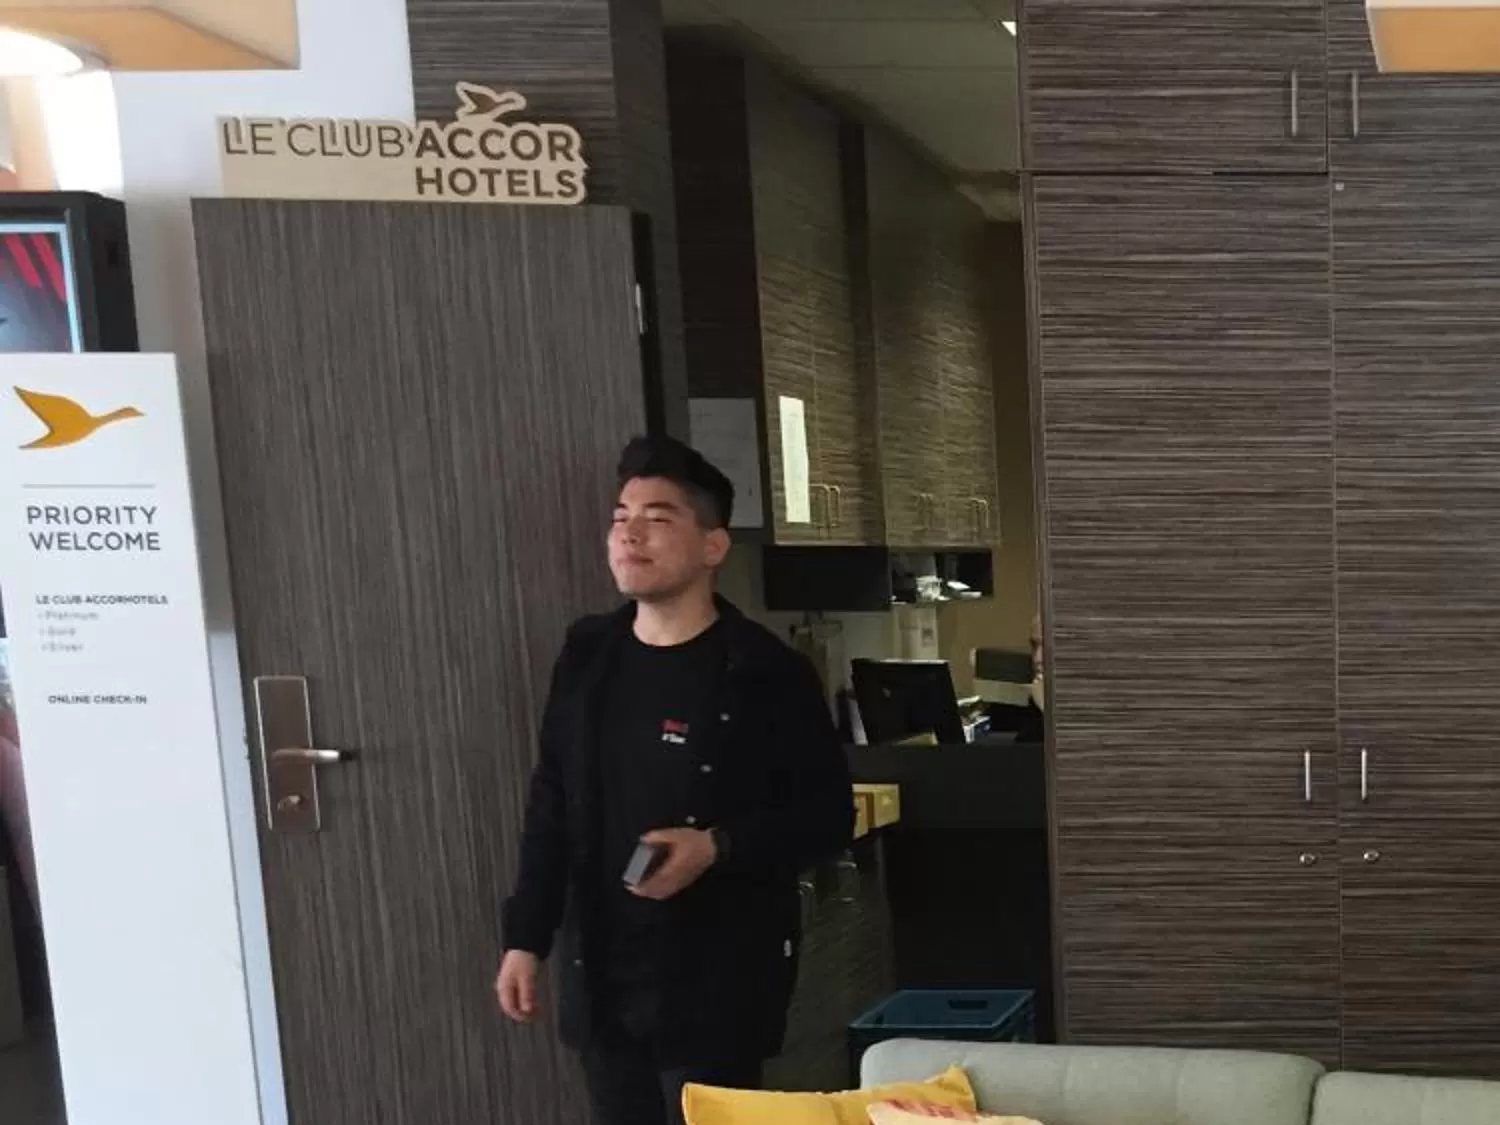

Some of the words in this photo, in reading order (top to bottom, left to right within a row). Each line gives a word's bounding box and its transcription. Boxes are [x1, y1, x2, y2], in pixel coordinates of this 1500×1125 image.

[223, 121, 277, 155] LE
[287, 124, 406, 158] CLUB
[415, 126, 576, 162] ACCOR
[415, 166, 578, 199] HOTELS
[26, 505, 158, 525] PRIORITY
[28, 531, 161, 551] WELCOME
[35, 594, 50, 605] LE
[52, 594, 82, 605] CLUB
[85, 594, 169, 606] ACCORHOTELS
[48, 694, 90, 705] ONLINE
[93, 694, 148, 705] CHECK-IN
